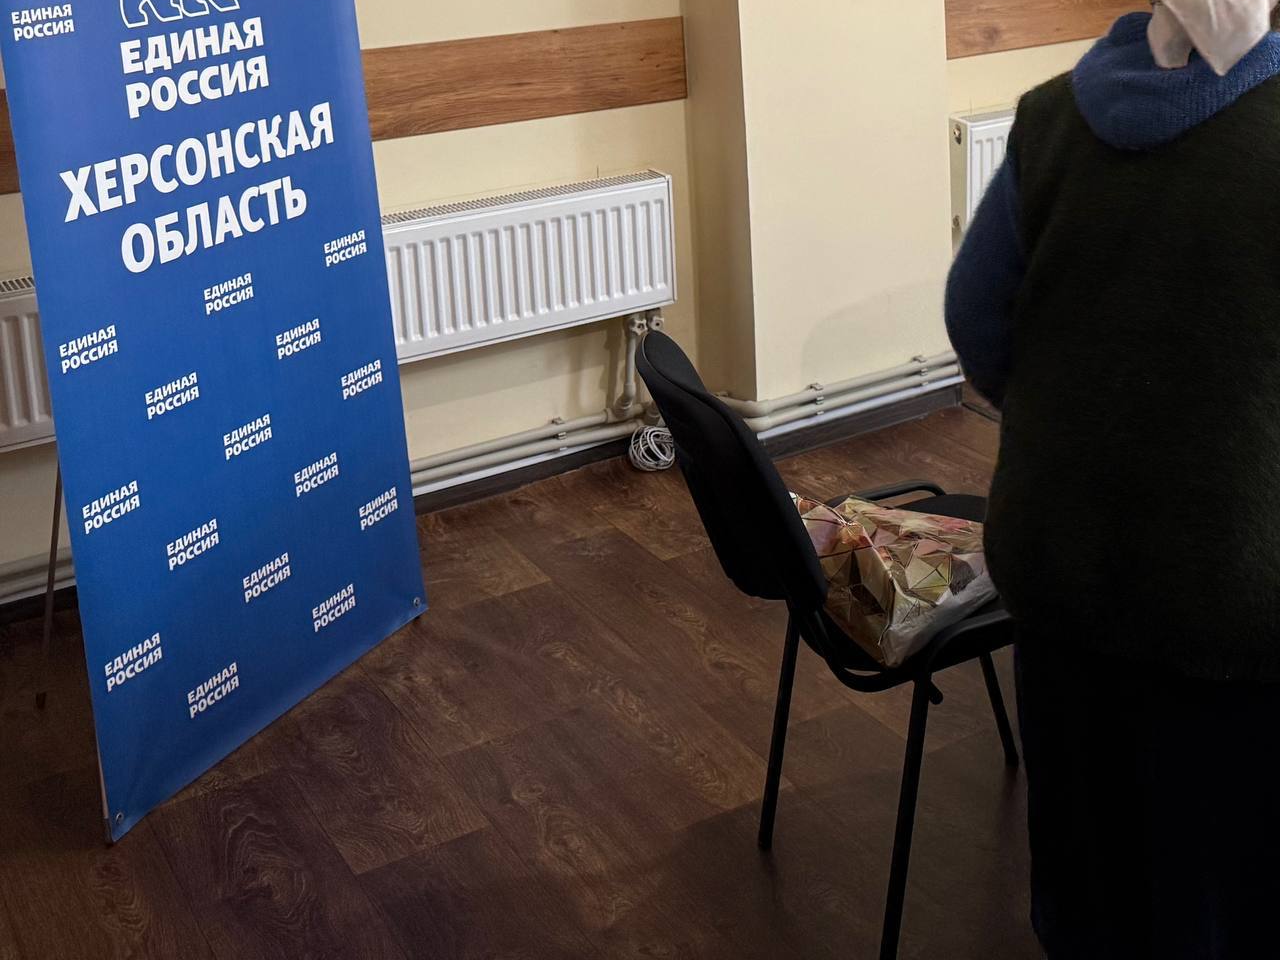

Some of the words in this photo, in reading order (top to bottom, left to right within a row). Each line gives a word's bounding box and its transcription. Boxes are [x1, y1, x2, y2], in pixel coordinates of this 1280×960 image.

[12, 4, 72, 25] ЕДИНАЯ
[14, 19, 74, 41] РОССИЯ
[120, 17, 264, 74] ЕДИНАЯ
[126, 55, 269, 119] РОССИЯ
[59, 102, 334, 222] ХЕРСОНСКАЯ
[121, 175, 307, 274] ОБЛАСТЬ
[324, 230, 365, 253] ЕДИНАЯ
[326, 242, 367, 267] РОССИЯ
[204, 273, 252, 300] ЕДИНАЯ
[206, 286, 253, 315] РОССИЯ
[60, 325, 116, 357] ЕДИНАЯ
[276, 319, 319, 345] ЕДИНАЯ
[278, 331, 321, 359] РОССИЯ
[62, 340, 118, 373] РОССИЯ
[145, 372, 197, 404] ЕДИНАЯ
[341, 360, 381, 387] ЕДИНАЯ
[343, 371, 382, 399] РОССИЯ
[147, 386, 199, 419] РОССИЯ
[224, 414, 270, 446] ЕДИНАЯ
[225, 427, 272, 460] РОССИЯ
[294, 452, 337, 484] ЕДИНАЯ
[296, 464, 338, 497] РОССИЯ
[83, 481, 138, 518] ЕДИНАЯ
[85, 495, 140, 534] РОССИЯ
[359, 487, 396, 517] ЕДИНАЯ
[361, 499, 398, 530] РОССИЯ
[167, 519, 217, 556] ЕДИНАЯ
[169, 532, 219, 570] РОССИЯ
[243, 552, 288, 589] ЕДИНАЯ
[245, 565, 290, 602] РОССИЯ
[312, 584, 353, 619] ЕДИНАЯ
[314, 596, 355, 632] РОССИЯ
[105, 633, 160, 676] ЕДИНАЯ
[107, 647, 162, 692] РОССИЯ
[188, 662, 237, 704] ЕДИНАЯ
[190, 675, 239, 718] РОССИЯ
